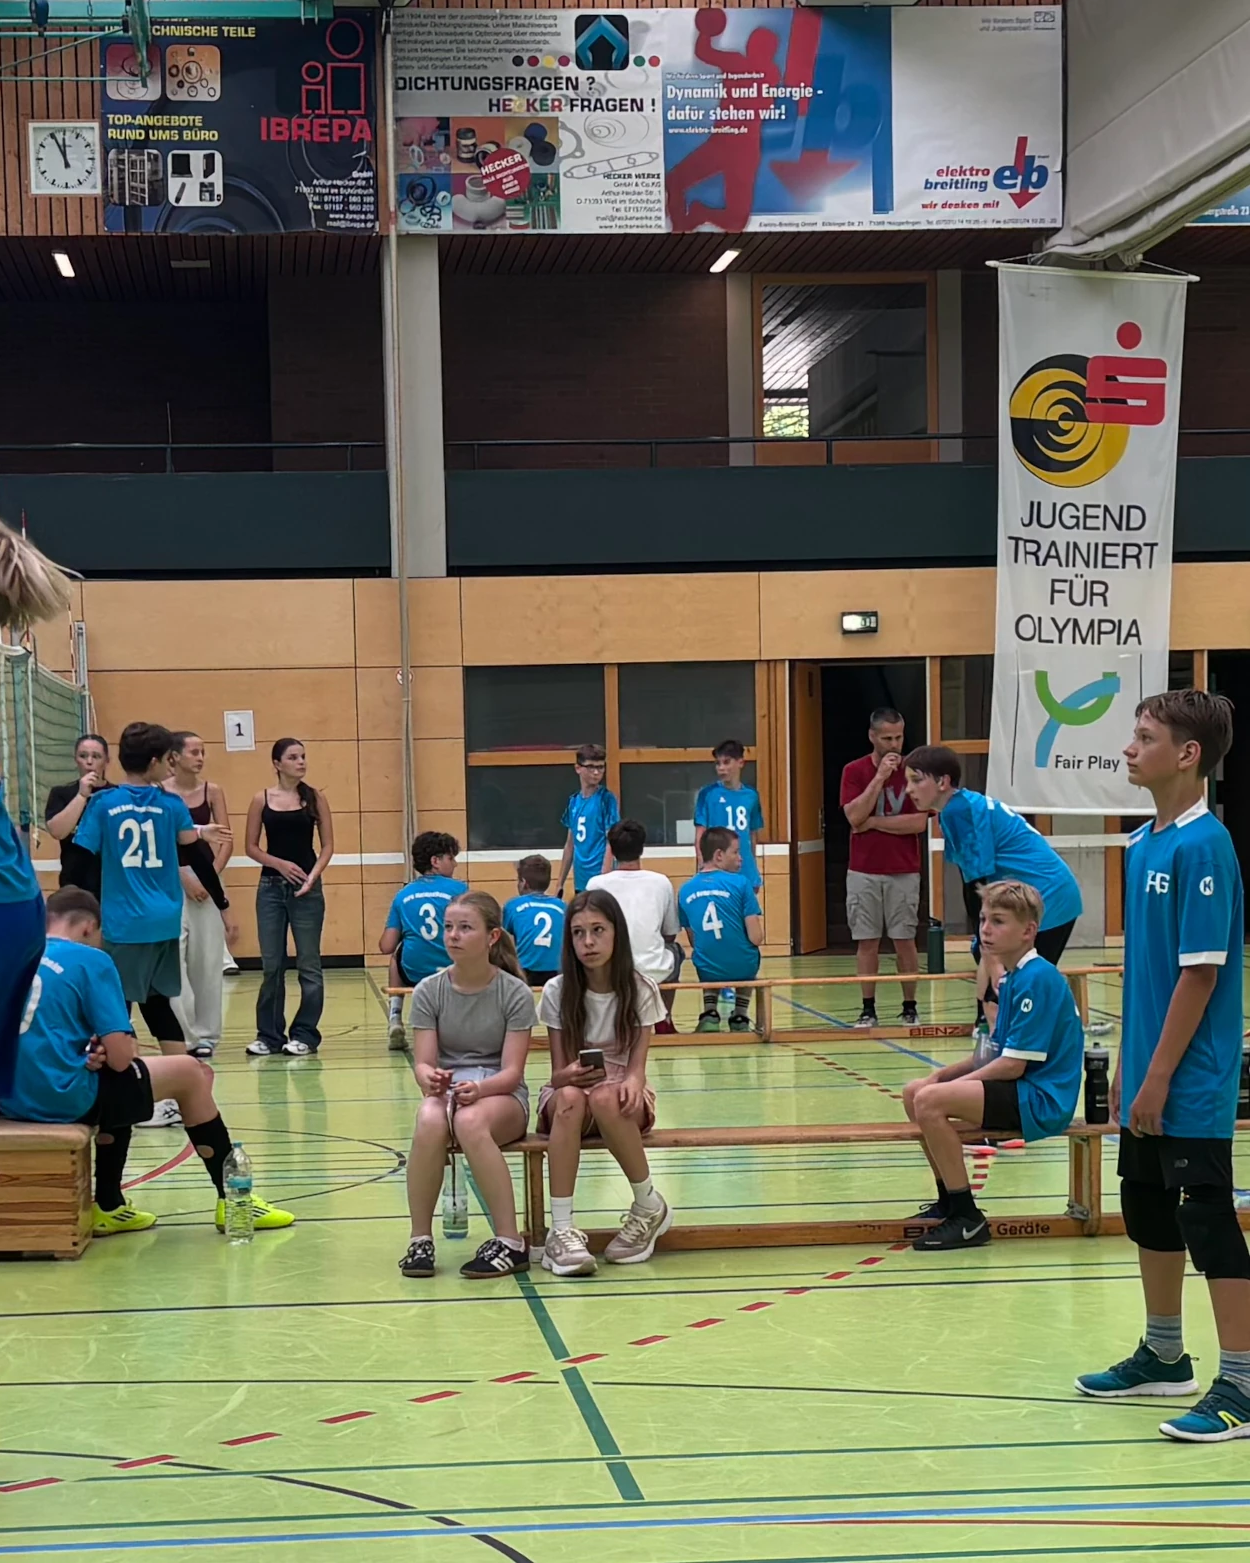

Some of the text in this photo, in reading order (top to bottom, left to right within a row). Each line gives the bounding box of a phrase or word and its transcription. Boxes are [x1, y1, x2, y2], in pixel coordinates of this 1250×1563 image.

[222, 26, 256, 38] TEILE
[396, 76, 579, 91] DICHTUNGSFRAGEN
[667, 84, 728, 100] Dynamik
[731, 83, 758, 98] und
[762, 83, 813, 100] Energie
[489, 98, 563, 113] HECKER
[569, 97, 644, 112] FRAGEN
[667, 105, 786, 121] dafür stehen wir!
[107, 114, 203, 127] TOP-ANGEBOTE
[260, 117, 372, 142] IBREPA
[108, 128, 219, 141] RUND UMS BÜRO
[480, 153, 522, 176] HECKER
[936, 165, 990, 178] elektro
[924, 178, 988, 192] breitling
[921, 200, 1000, 209] wir denken mit
[1020, 501, 1146, 532] JUGEND
[1007, 536, 1158, 570] TRAINIERT
[1050, 574, 1109, 607] FÜR
[1014, 613, 1142, 646] OLYMPIA
[235, 722, 244, 737] 1
[1054, 754, 1121, 774] Fair Play
[726, 805, 747, 831] 18
[576, 816, 586, 842] 5
[119, 818, 163, 868] 21
[419, 903, 439, 941] 3
[533, 911, 552, 948] 2
[702, 901, 724, 940] 4
[910, 1027, 960, 1036] BENZ
[997, 1223, 1050, 1236] Geräte
